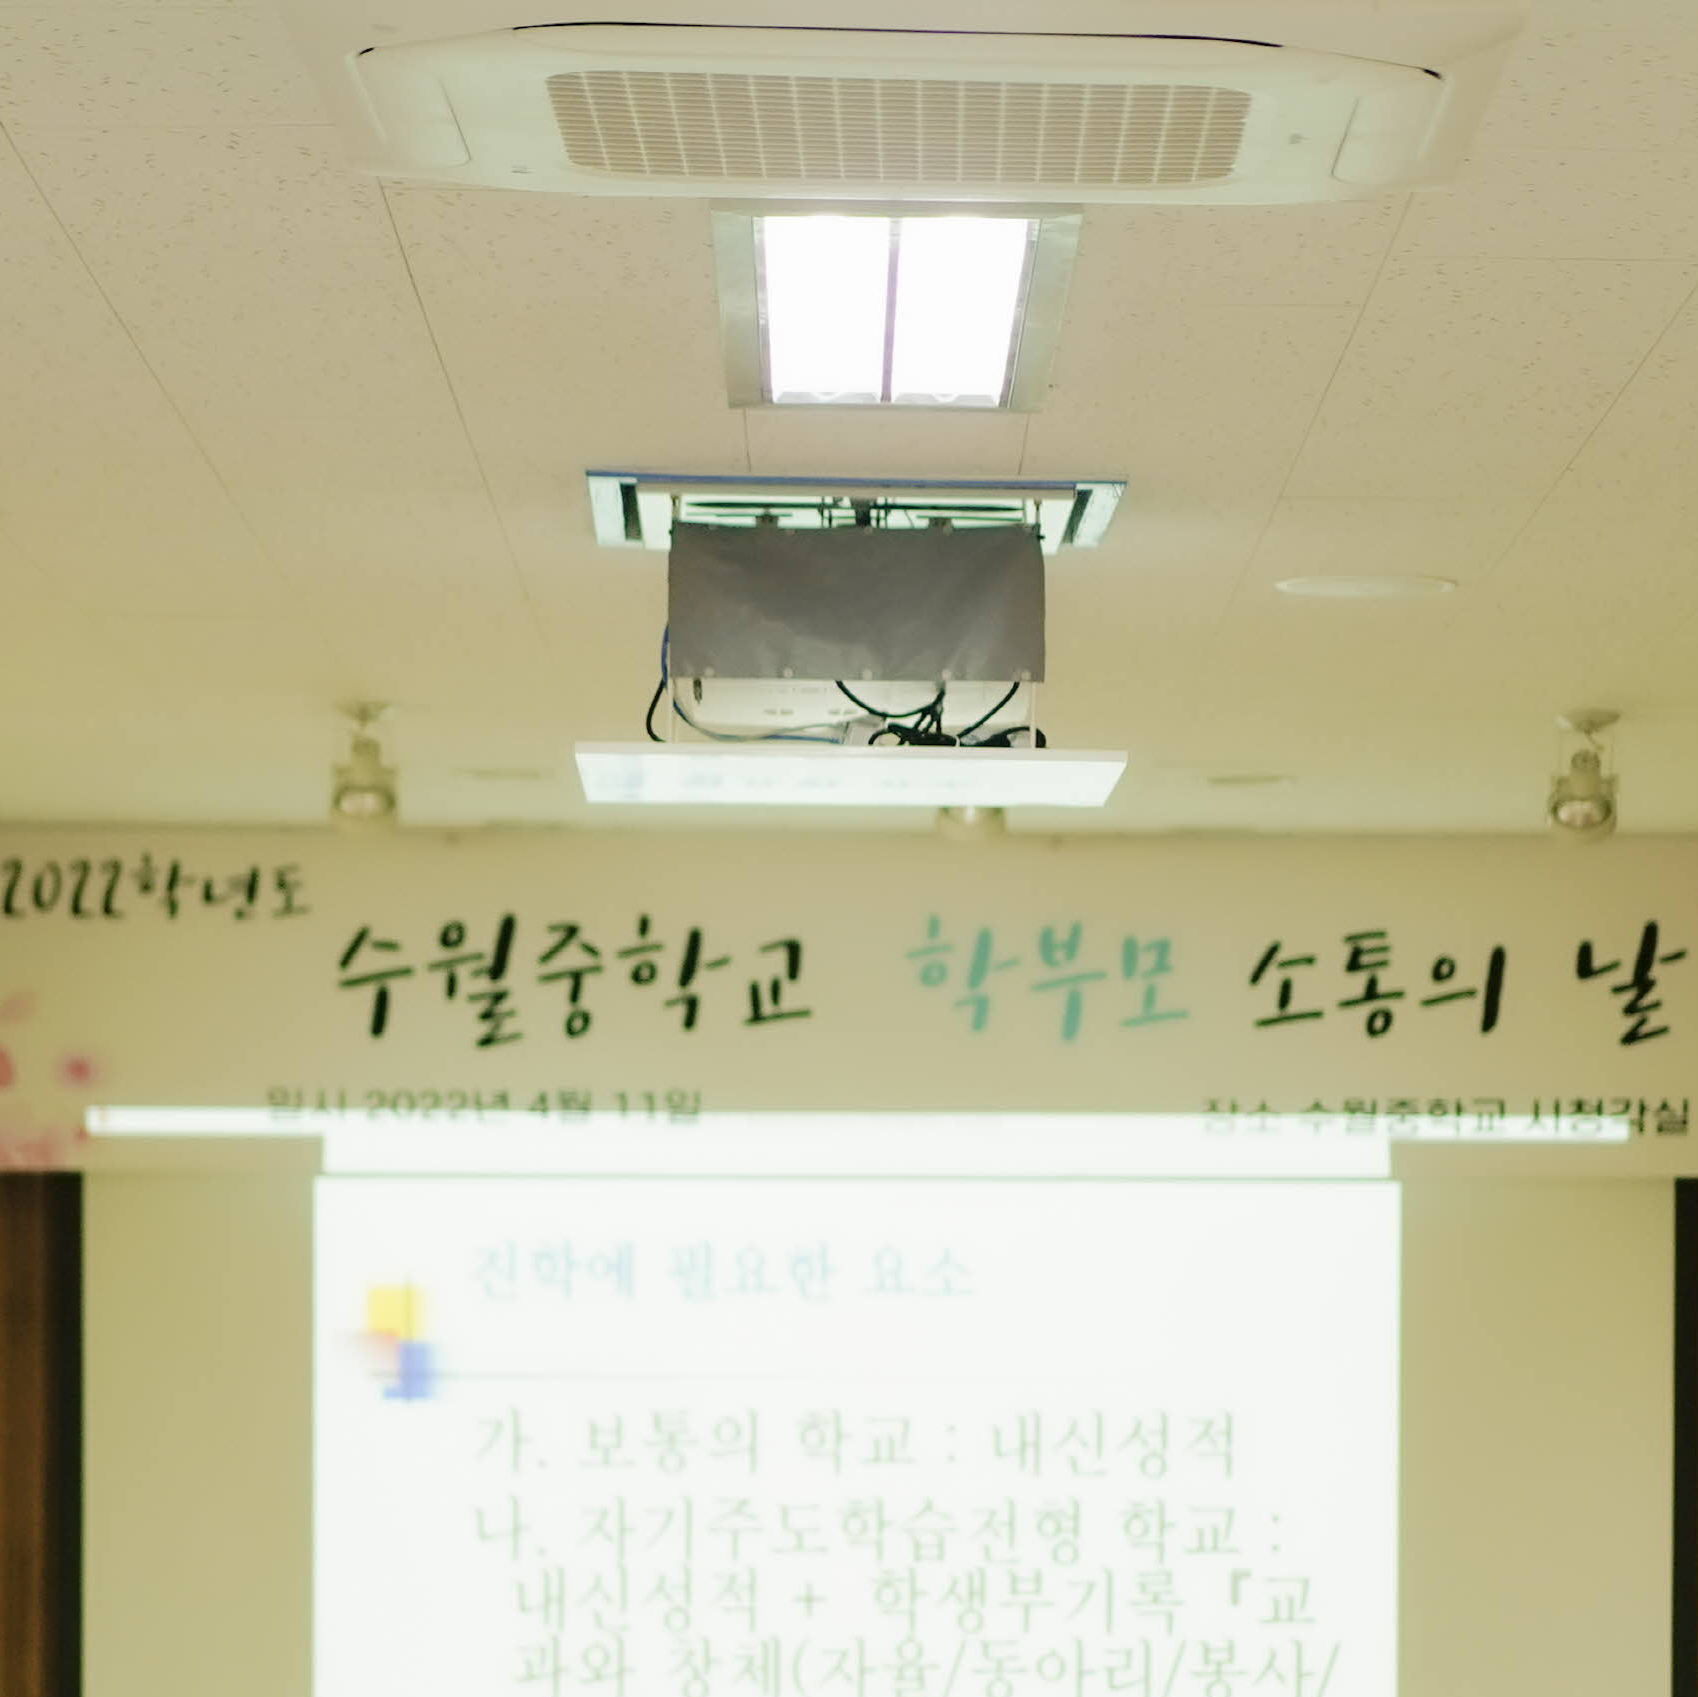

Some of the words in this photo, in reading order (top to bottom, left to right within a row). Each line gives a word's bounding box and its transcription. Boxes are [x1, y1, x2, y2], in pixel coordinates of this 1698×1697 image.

[0, 852, 312, 920] 2022학년도
[339, 914, 811, 1047] 수월중학교
[906, 913, 1188, 1042] 학부모
[1248, 929, 1508, 1039] 소통의
[1575, 920, 1686, 1045] 날
[365, 1088, 513, 1121] 2022년
[529, 1088, 593, 1122] 4월
[615, 1089, 700, 1122] 11일
[1299, 1097, 1504, 1136] 수월중학교
[1526, 1097, 1690, 1137] 시청각실
[472, 1239, 636, 1302] 진학에
[670, 1239, 837, 1303] 필요한
[863, 1244, 977, 1297] 요소
[474, 1405, 549, 1476] 가.
[577, 1405, 760, 1476] 보통의
[796, 1407, 918, 1476] 학교
[990, 1408, 1236, 1480] 내신성적
[472, 1493, 549, 1562] 나.
[575, 1494, 1082, 1566] 자기주도학습전형
[1121, 1496, 1243, 1565] 학교
[513, 1563, 760, 1634] 내신성적
[872, 1565, 1185, 1636] 학생부기록
